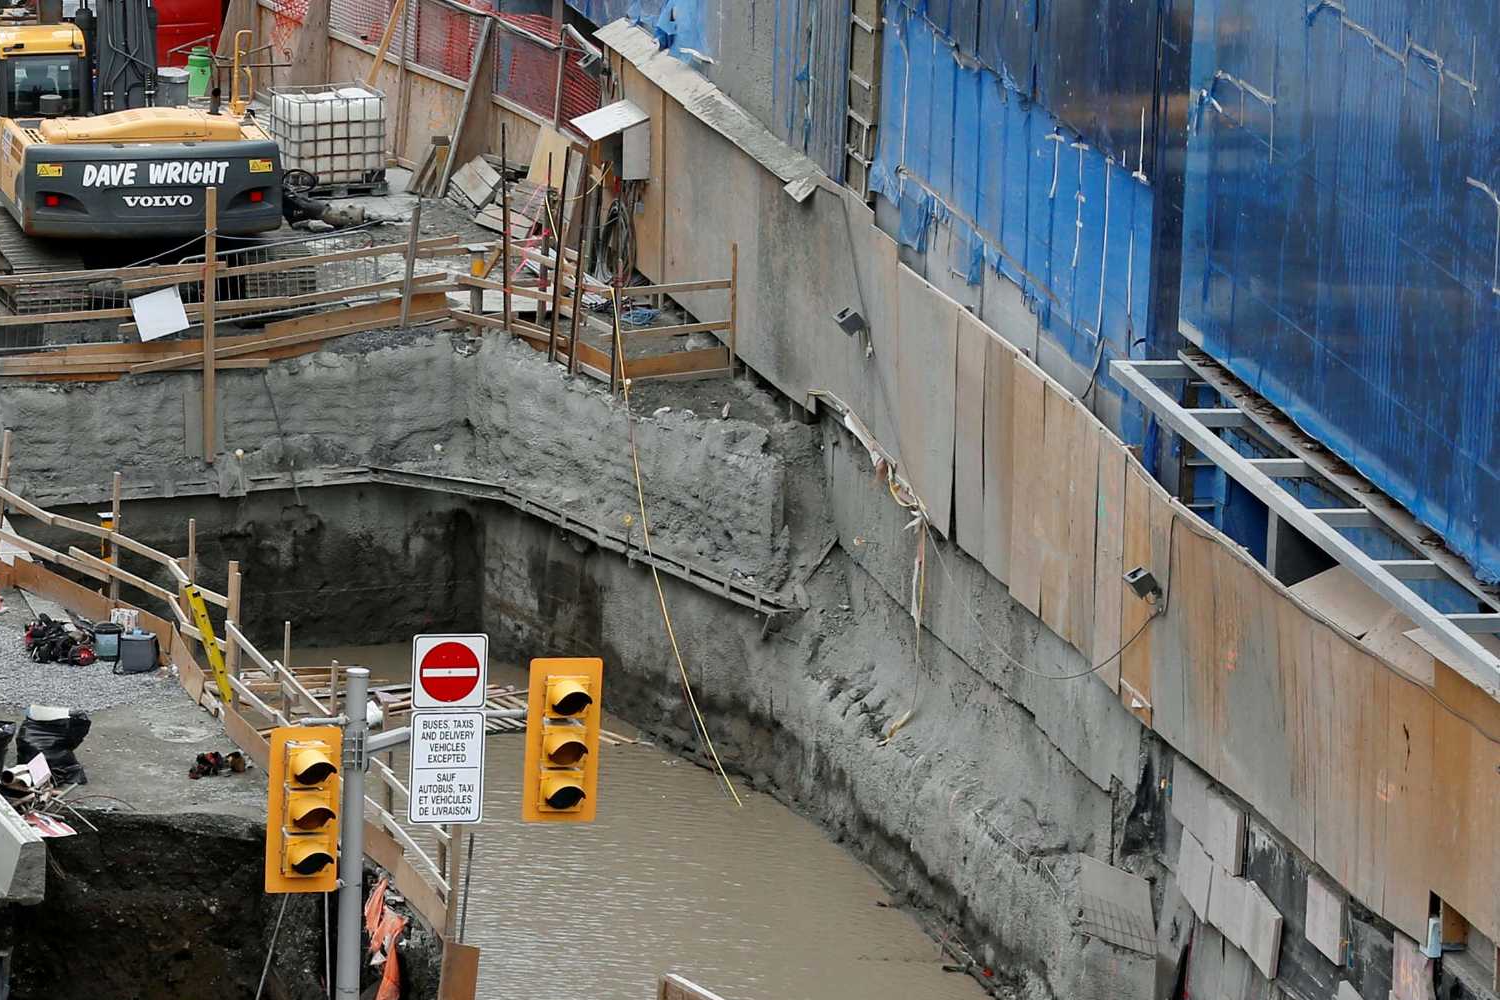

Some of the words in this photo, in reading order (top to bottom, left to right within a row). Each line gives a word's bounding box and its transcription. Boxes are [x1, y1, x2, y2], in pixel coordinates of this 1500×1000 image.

[82, 163, 138, 187] DAVE
[149, 161, 229, 184] WRIGHT
[122, 194, 193, 207] VOLVO
[423, 720, 450, 730] BUSES,
[453, 719, 474, 729] TAXIS
[421, 731, 437, 741] AND
[439, 731, 475, 740] DELIVERY
[429, 743, 466, 752] VEHICLES
[427, 754, 467, 763] EXCEPTED
[436, 773, 456, 782] SAUF
[418, 784, 455, 794] AUTOBUS,
[458, 784, 474, 793] TAXI
[419, 796, 428, 805] ET
[419, 807, 429, 816] DE
[432, 806, 471, 816] LIVRAISON
